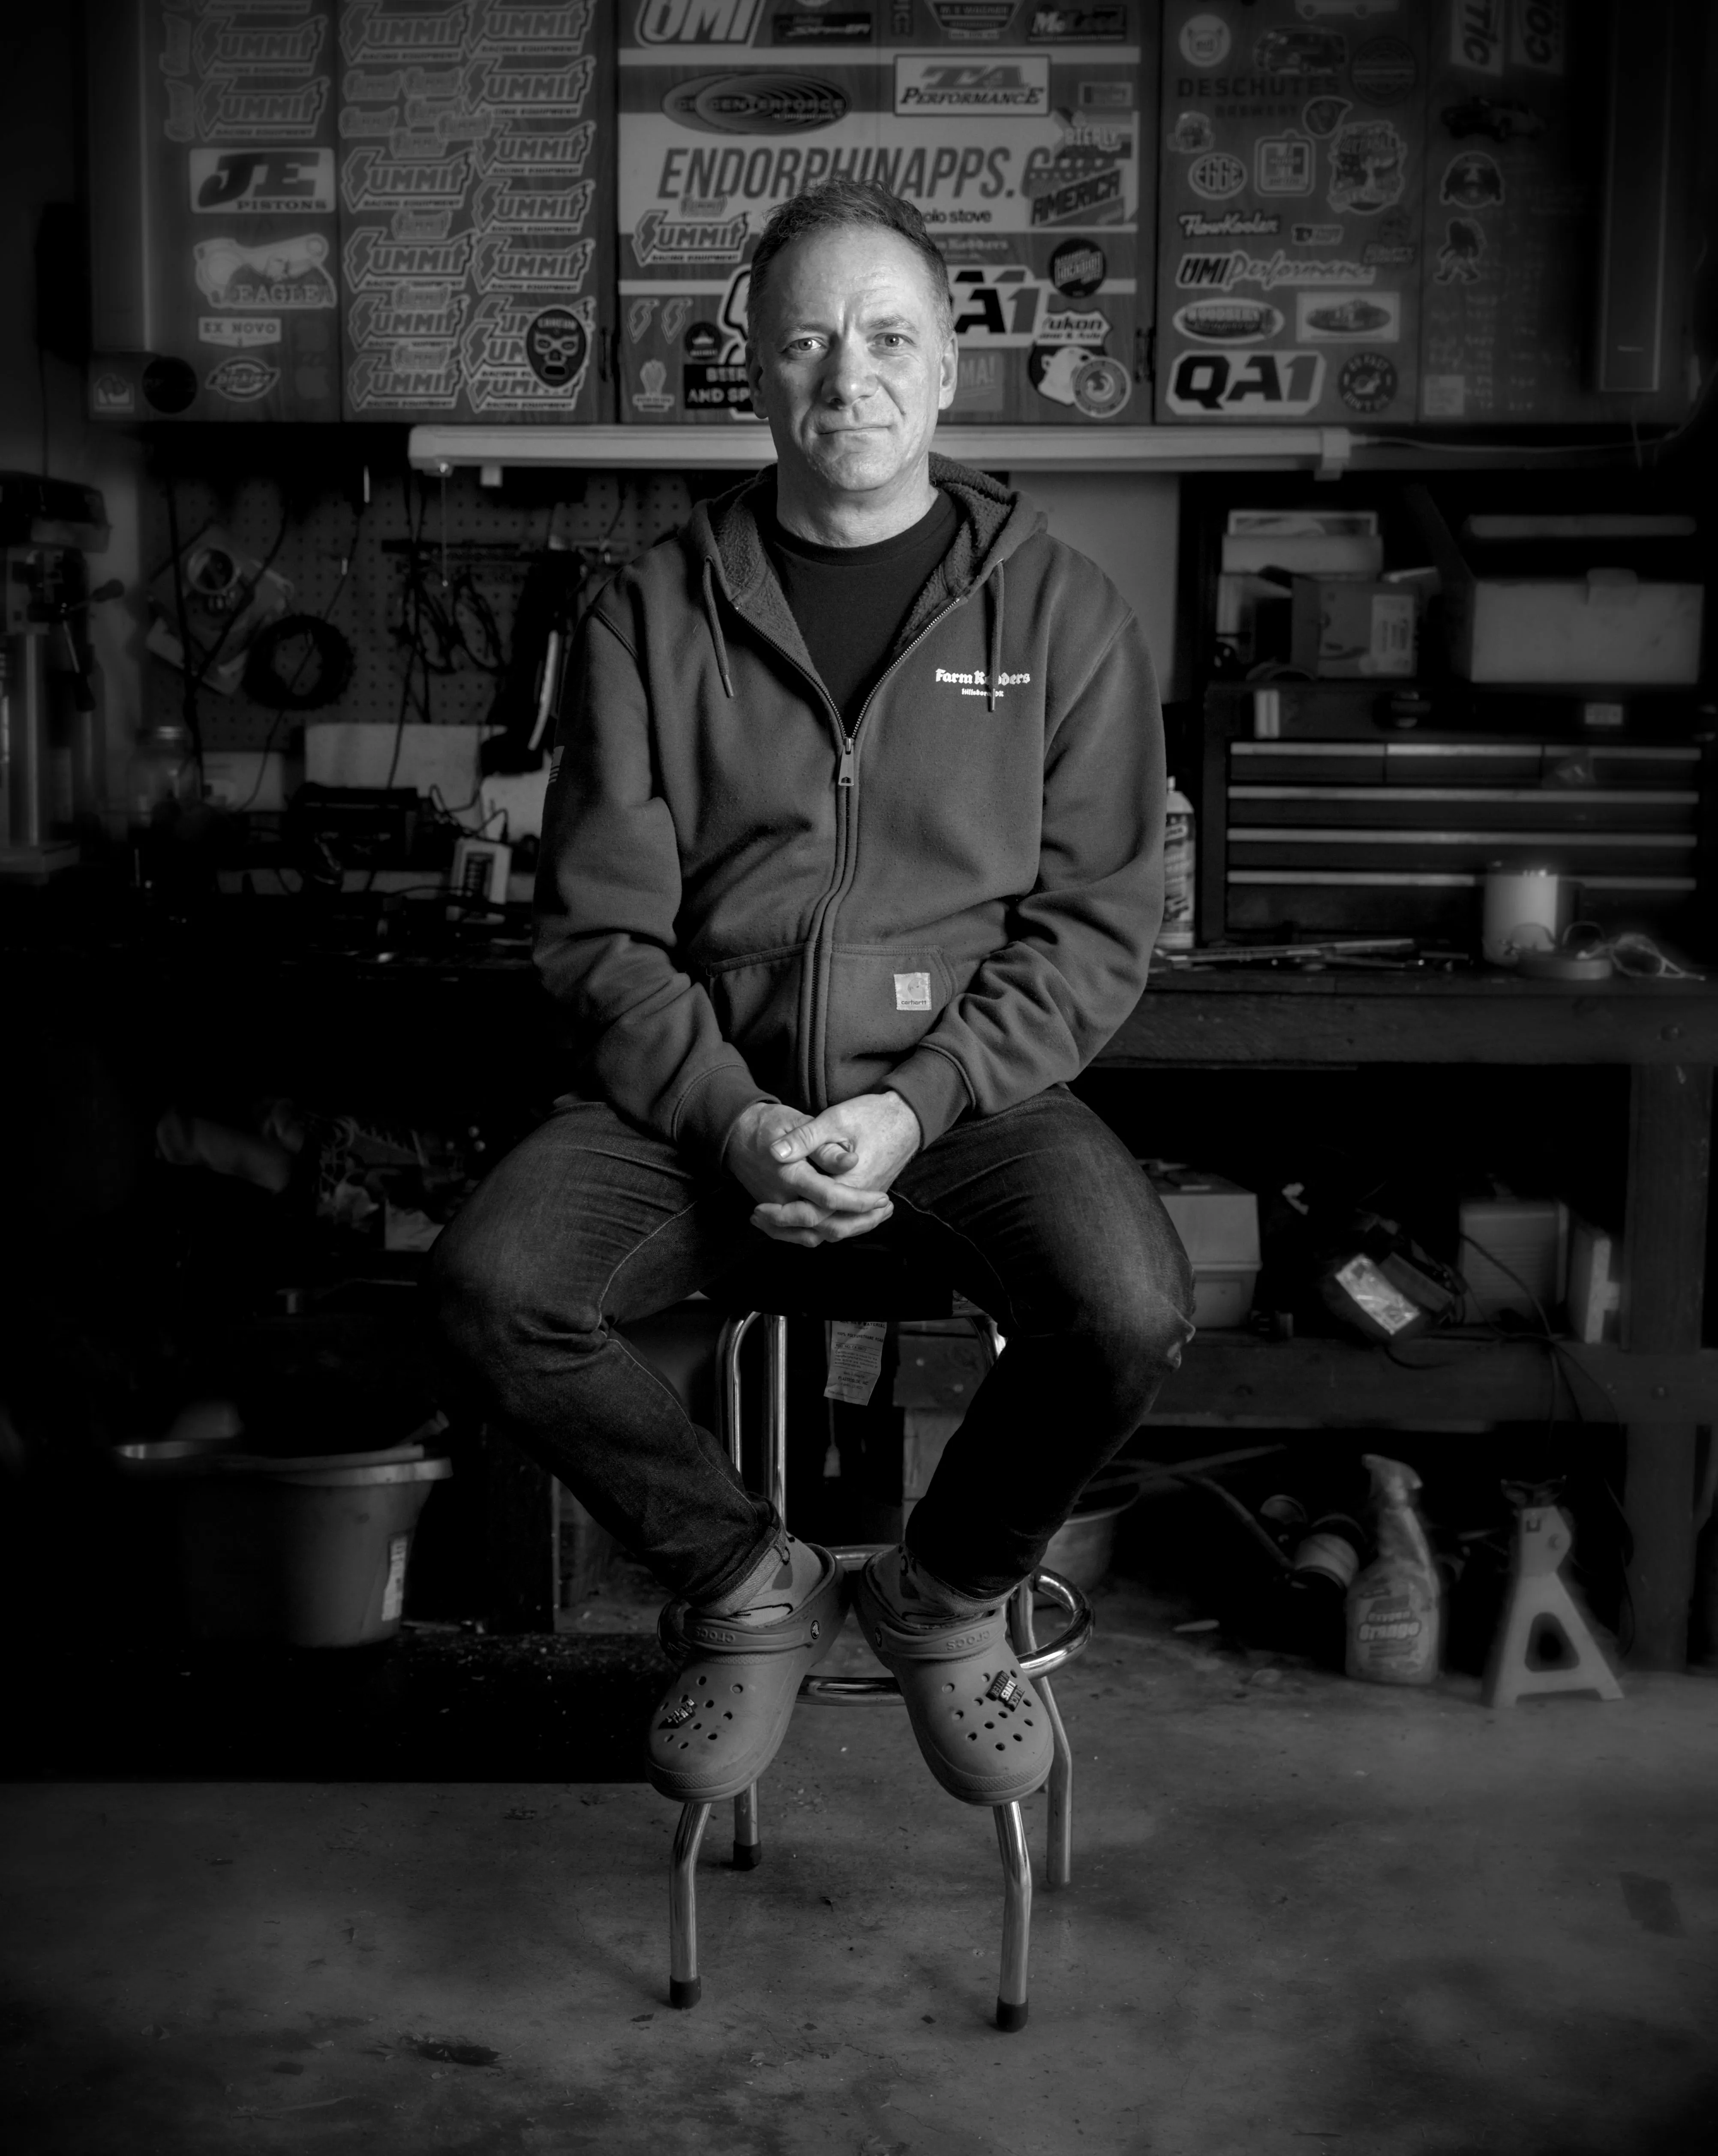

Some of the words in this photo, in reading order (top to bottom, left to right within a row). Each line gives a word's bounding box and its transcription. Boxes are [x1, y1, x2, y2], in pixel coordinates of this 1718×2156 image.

[901, 87, 1046, 105] PERFORMANCE
[1177, 77, 1341, 97] DESCHUTES
[198, 152, 321, 209] JE
[658, 148, 1054, 198] ENDORPHINAPPS.C
[237, 200, 327, 211] PISTONS
[1180, 258, 1229, 284] UMI
[235, 284, 318, 303] EAGLE
[232, 322, 277, 334] NOVO
[1175, 355, 1319, 409] QA1
[935, 668, 973, 684] Farm
[973, 670, 1030, 686] Rders
[695, 1627, 736, 1643] crocs
[946, 1630, 991, 1652] crocs
[991, 1671, 1010, 1697] MATTER
[1000, 1680, 1016, 1701] LIVES
